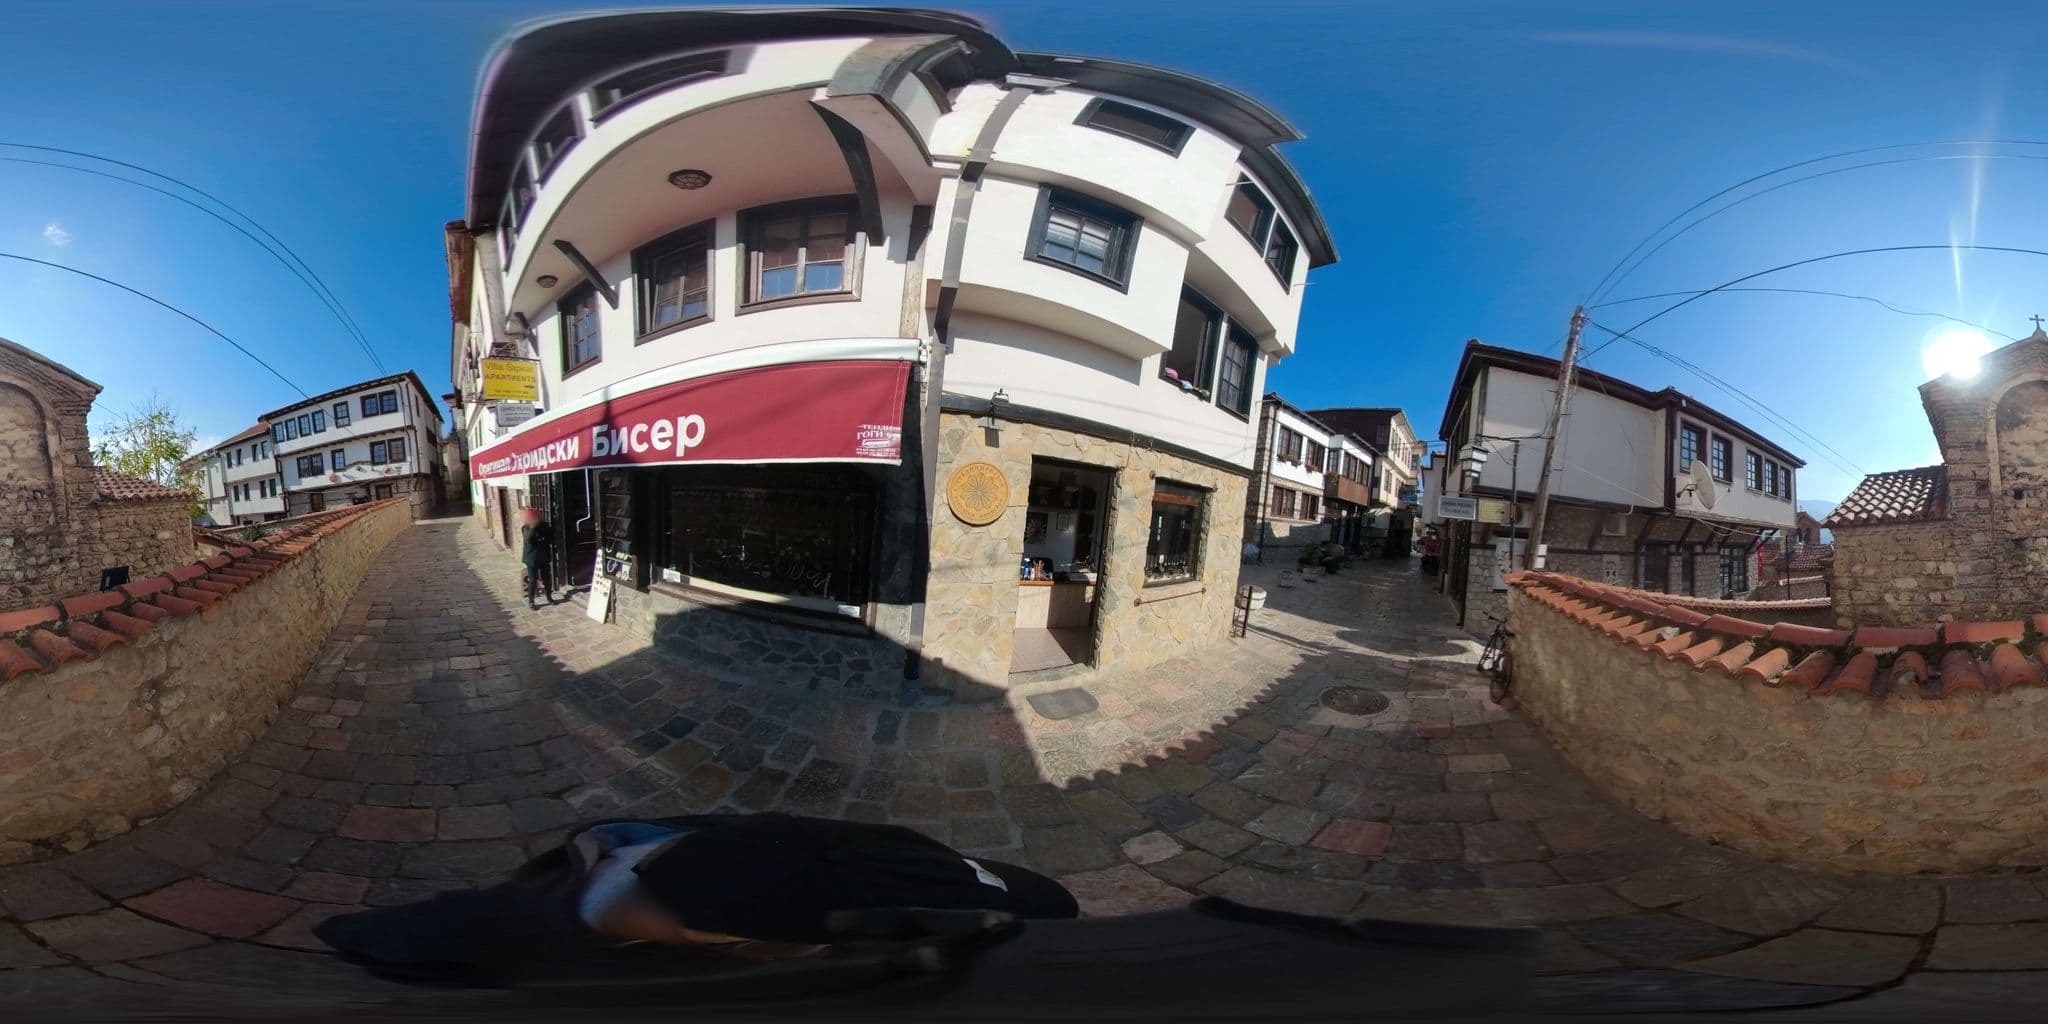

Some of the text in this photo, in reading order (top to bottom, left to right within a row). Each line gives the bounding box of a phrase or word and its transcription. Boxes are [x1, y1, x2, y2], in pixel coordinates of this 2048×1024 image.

[485, 362, 504, 371] Villa
[484, 373, 537, 383] APARTMENTS
[592, 414, 706, 457] Бисер
